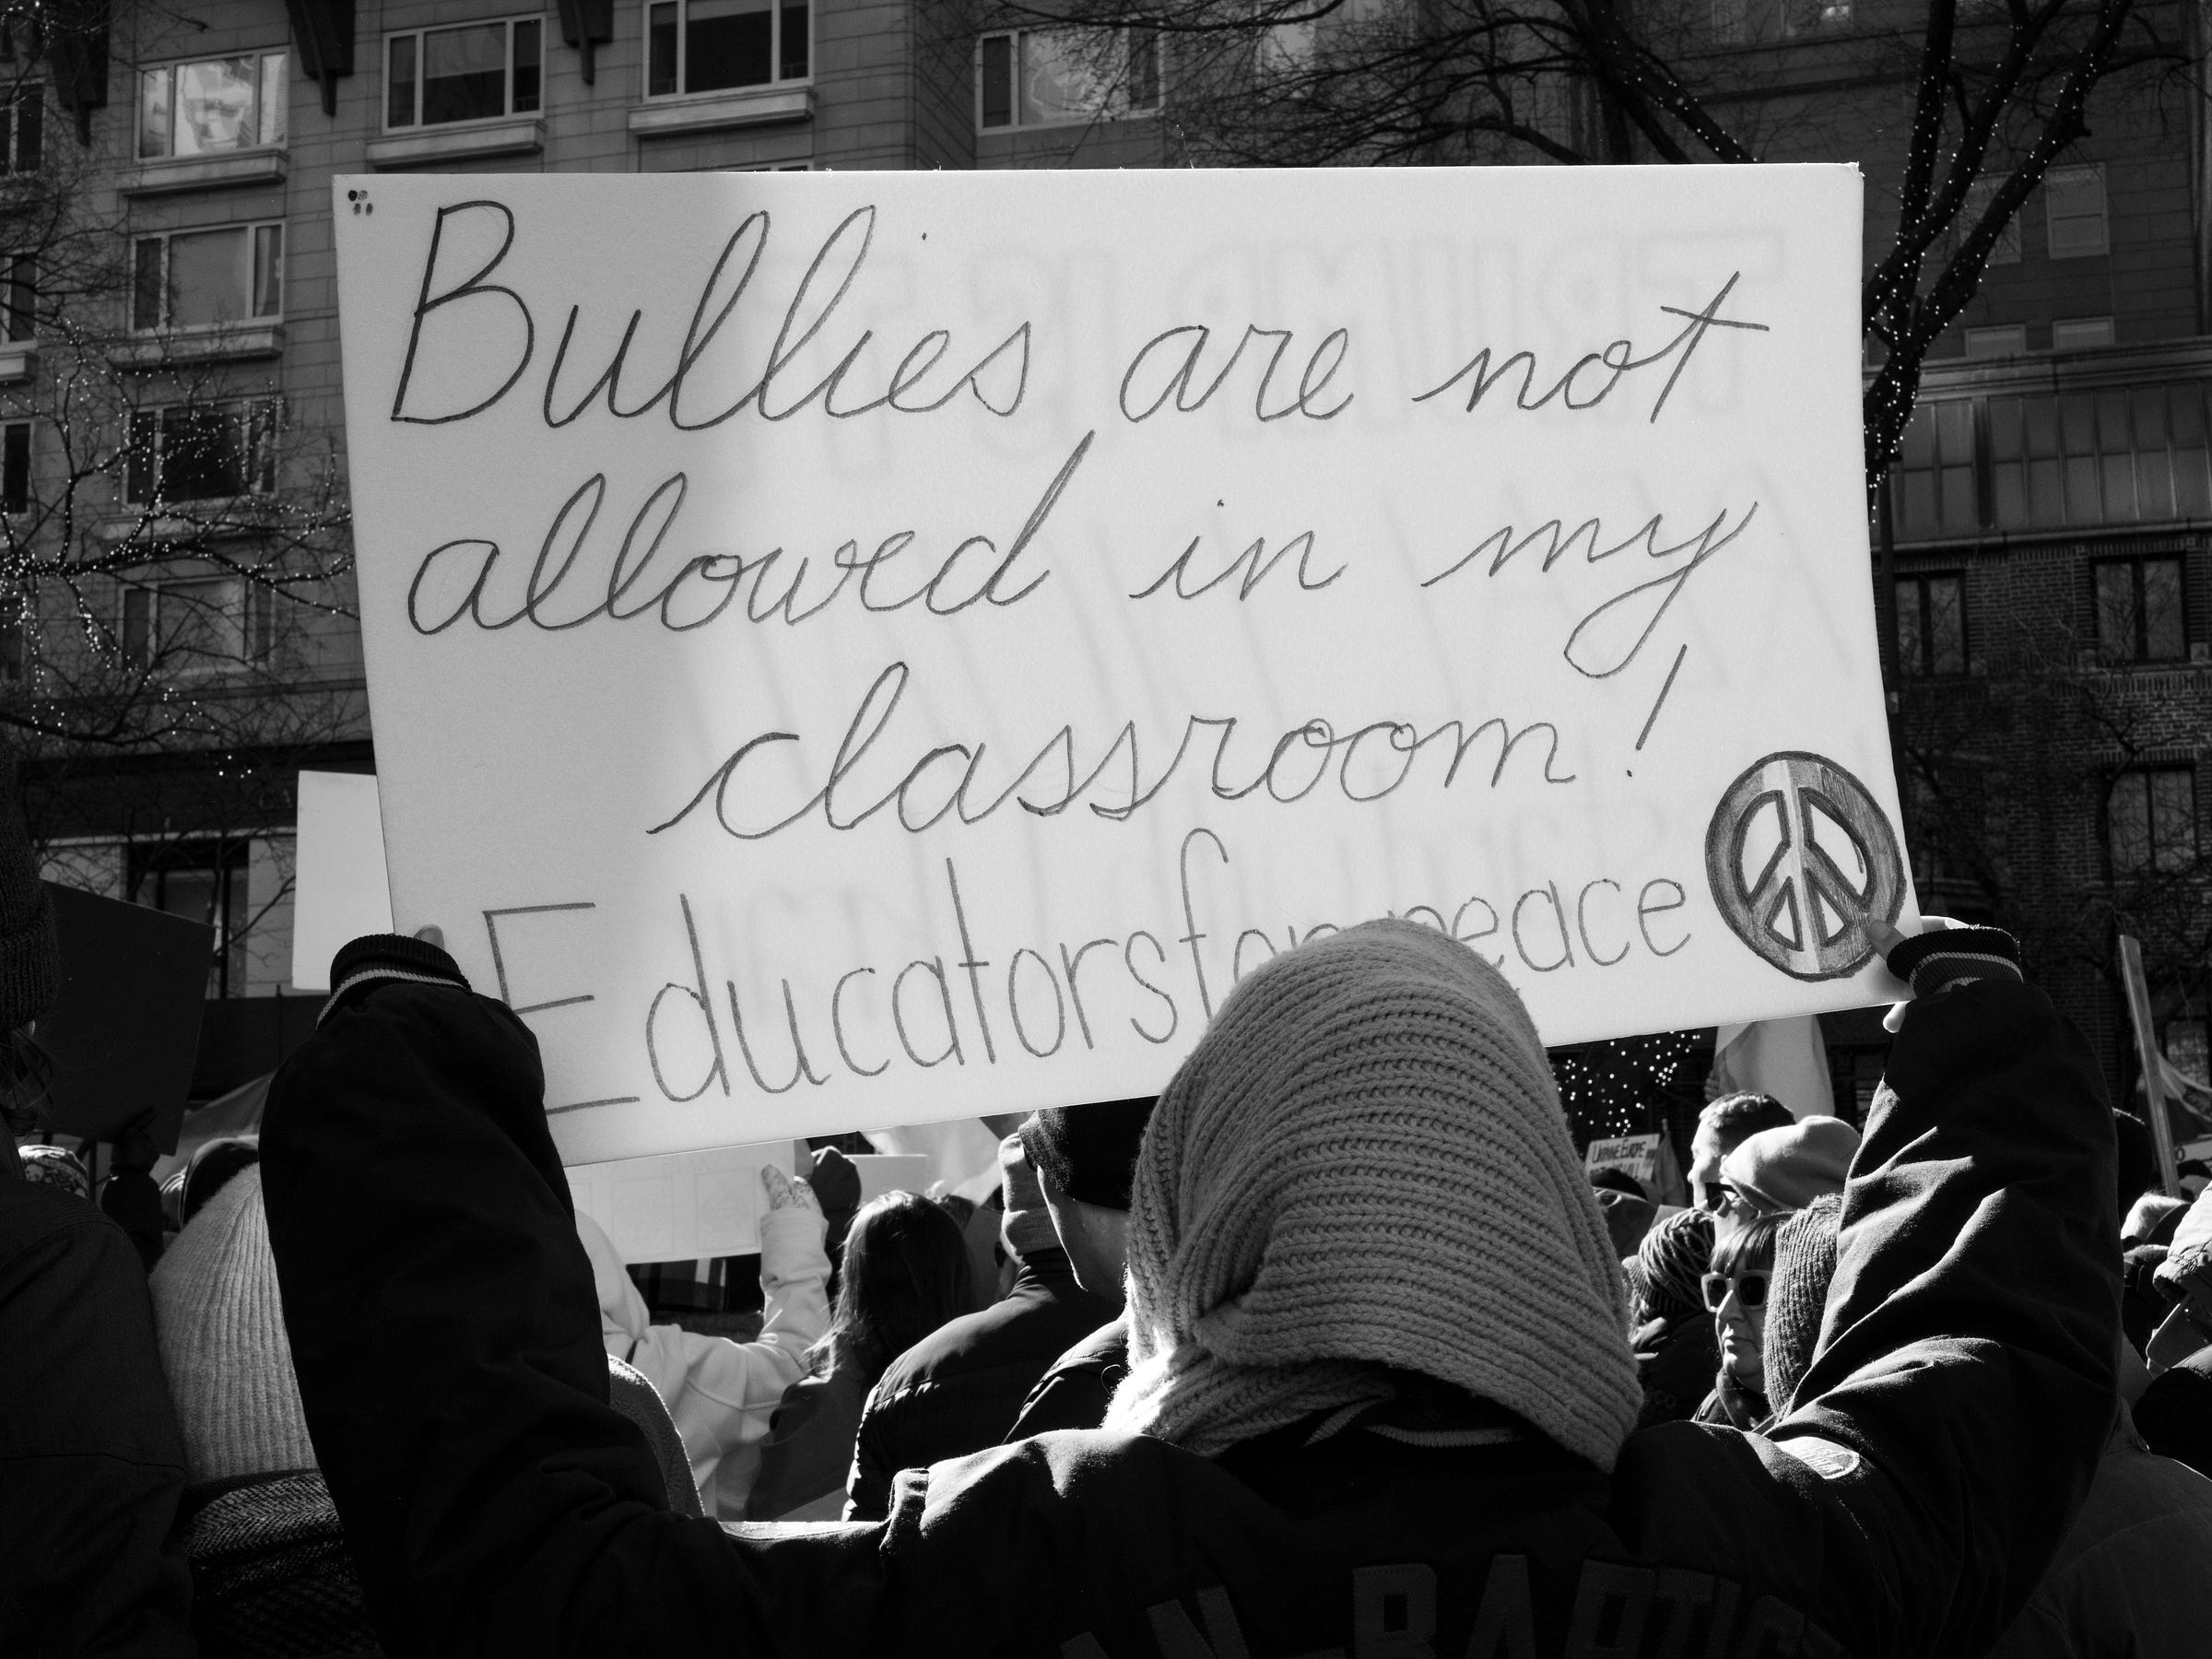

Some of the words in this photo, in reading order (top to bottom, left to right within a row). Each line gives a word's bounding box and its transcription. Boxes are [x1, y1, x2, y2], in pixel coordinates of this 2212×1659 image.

[389, 199, 1032, 431] Bullies
[1119, 323, 1355, 422] are
[1411, 270, 1771, 423] not
[407, 429, 1097, 636] allowed
[1128, 497, 1347, 601] in
[1420, 500, 1759, 678] my
[645, 643, 1688, 841] classroom!
